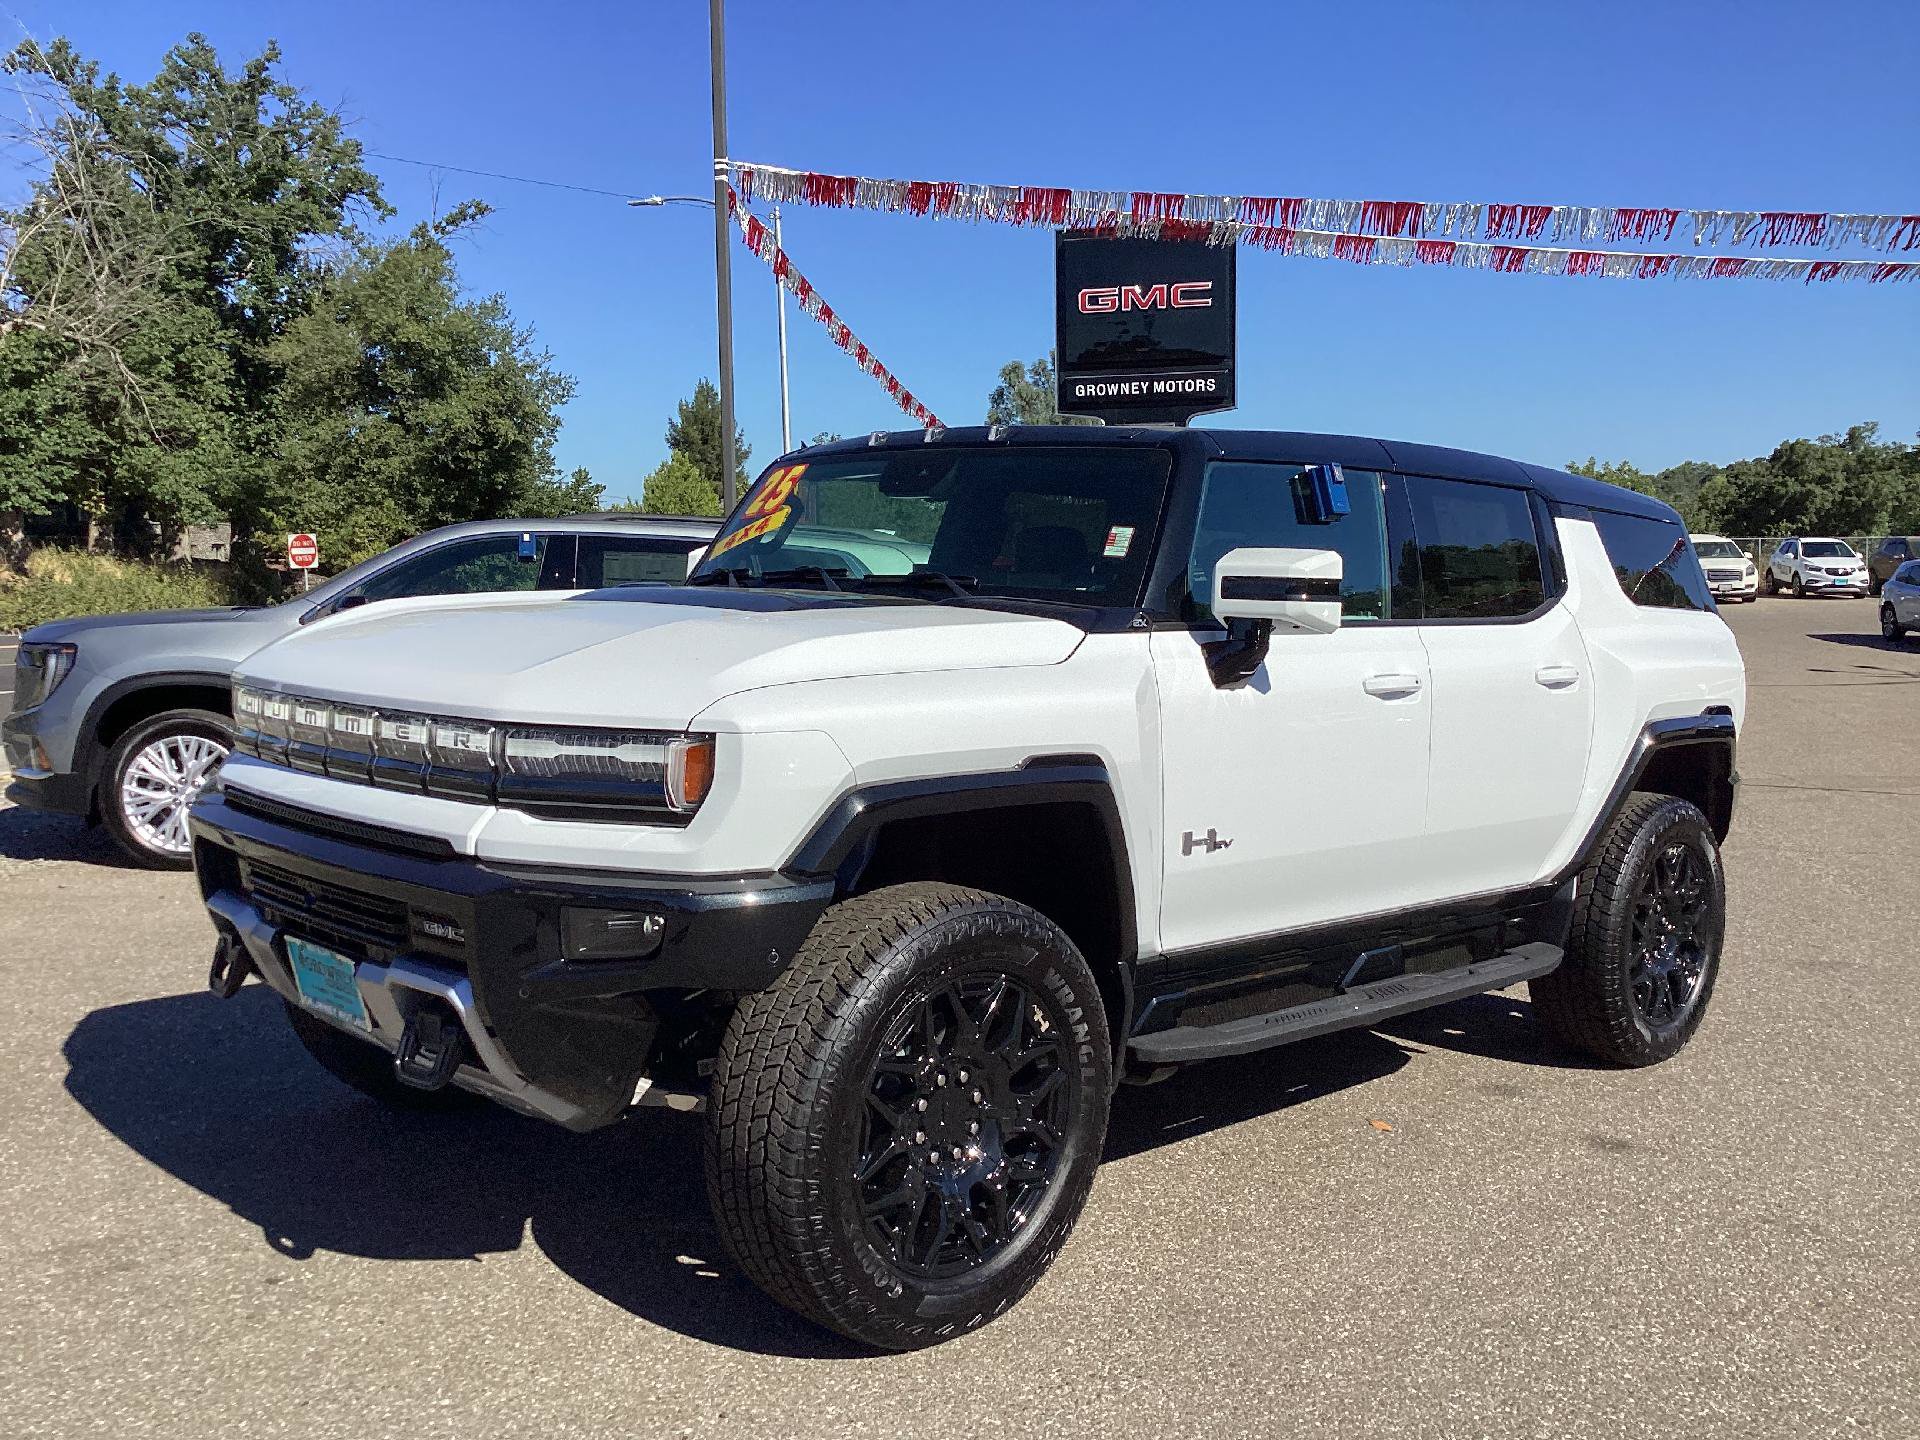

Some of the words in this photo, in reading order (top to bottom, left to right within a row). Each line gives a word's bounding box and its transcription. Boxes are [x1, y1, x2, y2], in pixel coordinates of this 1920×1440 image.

[1078, 281, 1212, 314] GMC
[1075, 382, 1149, 396] GROWNEY
[1153, 379, 1216, 394] MOTORS
[743, 464, 808, 516] 25
[425, 921, 465, 942] GMC
